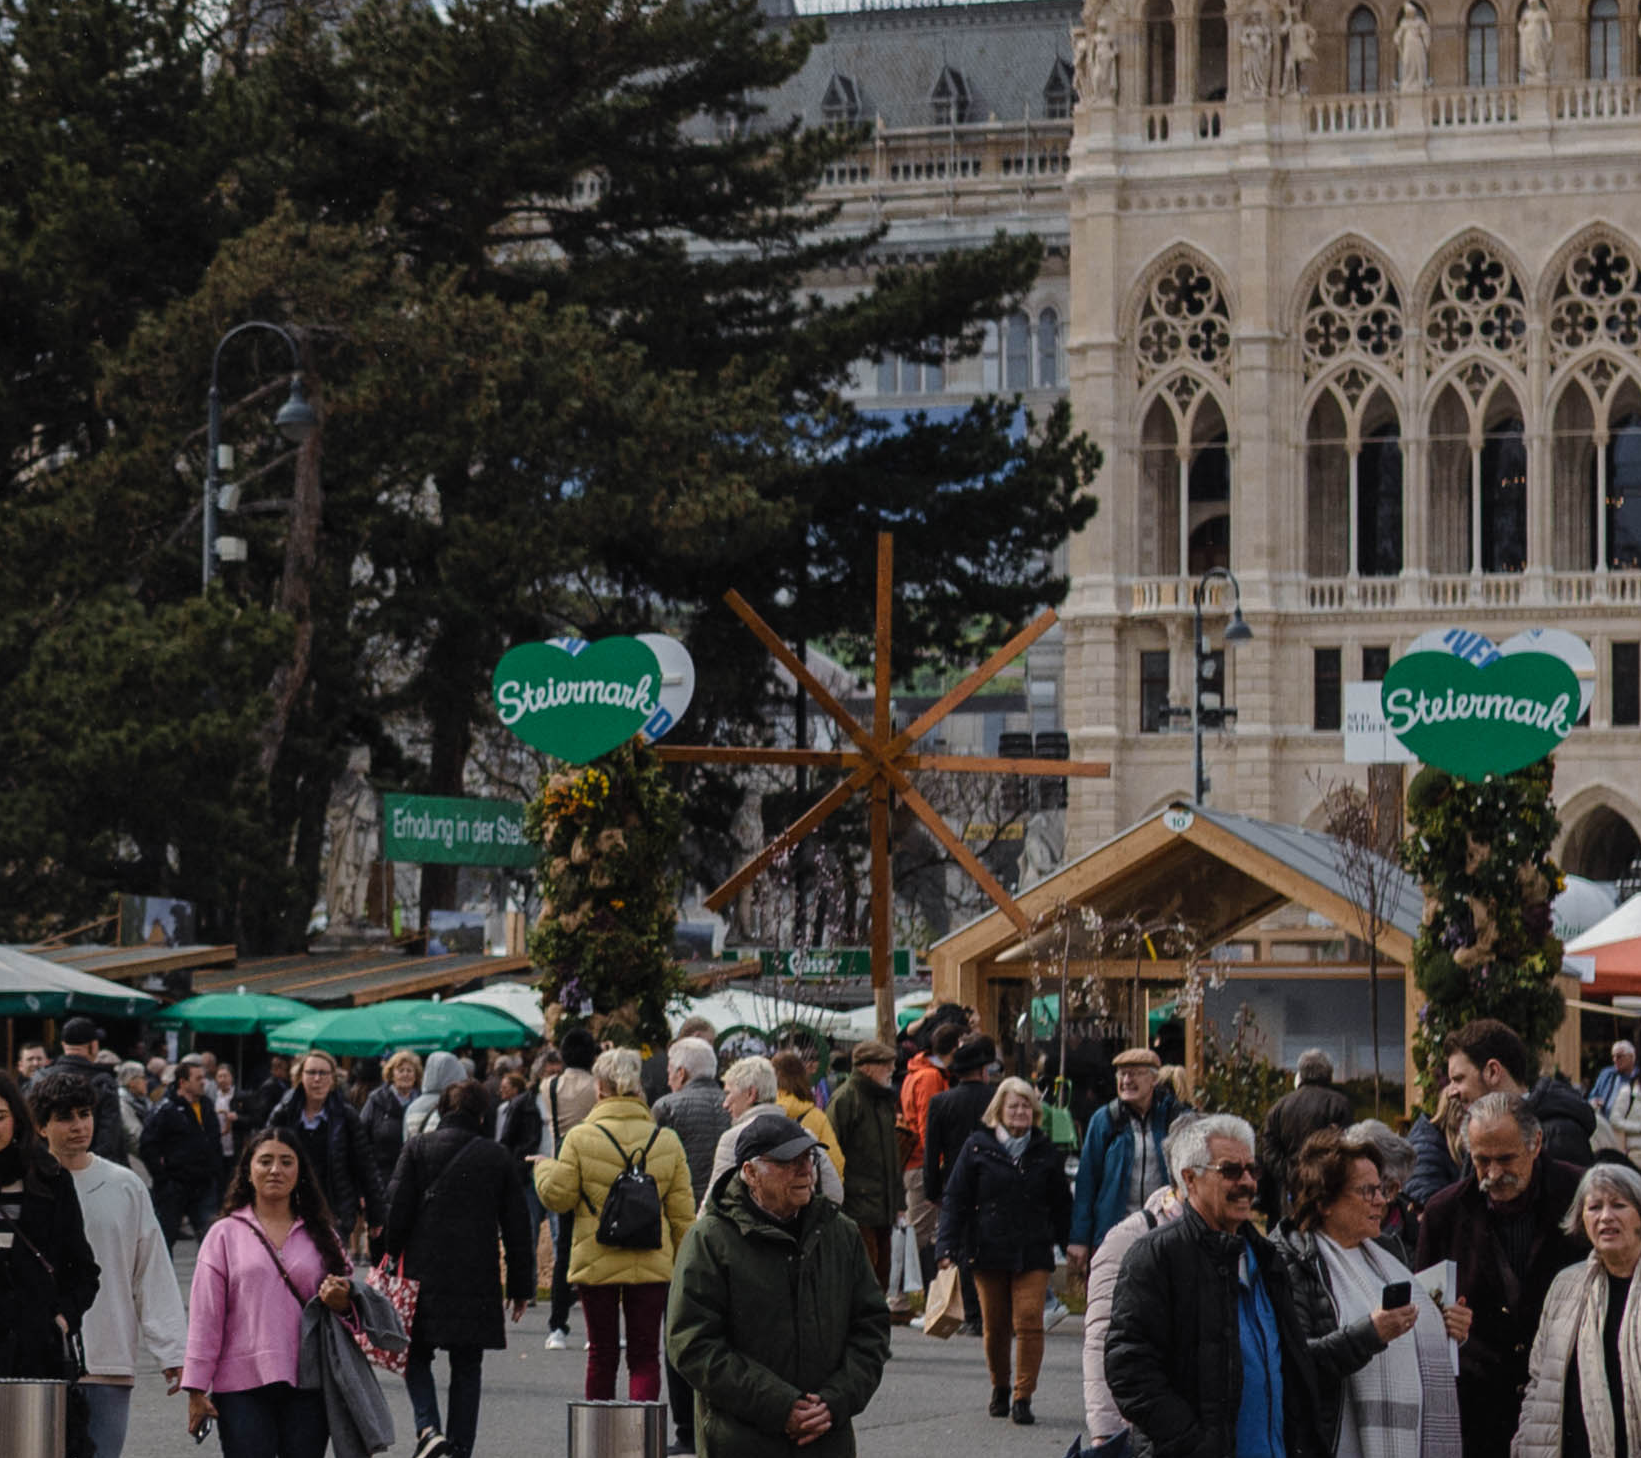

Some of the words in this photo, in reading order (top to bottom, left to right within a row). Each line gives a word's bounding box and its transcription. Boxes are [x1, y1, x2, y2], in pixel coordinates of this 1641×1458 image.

[498, 673, 656, 725] Steiermark
[1386, 688, 1572, 738] Steiermark
[392, 807, 455, 849] Erholung
[457, 814, 469, 841] in
[472, 819, 494, 844] der
